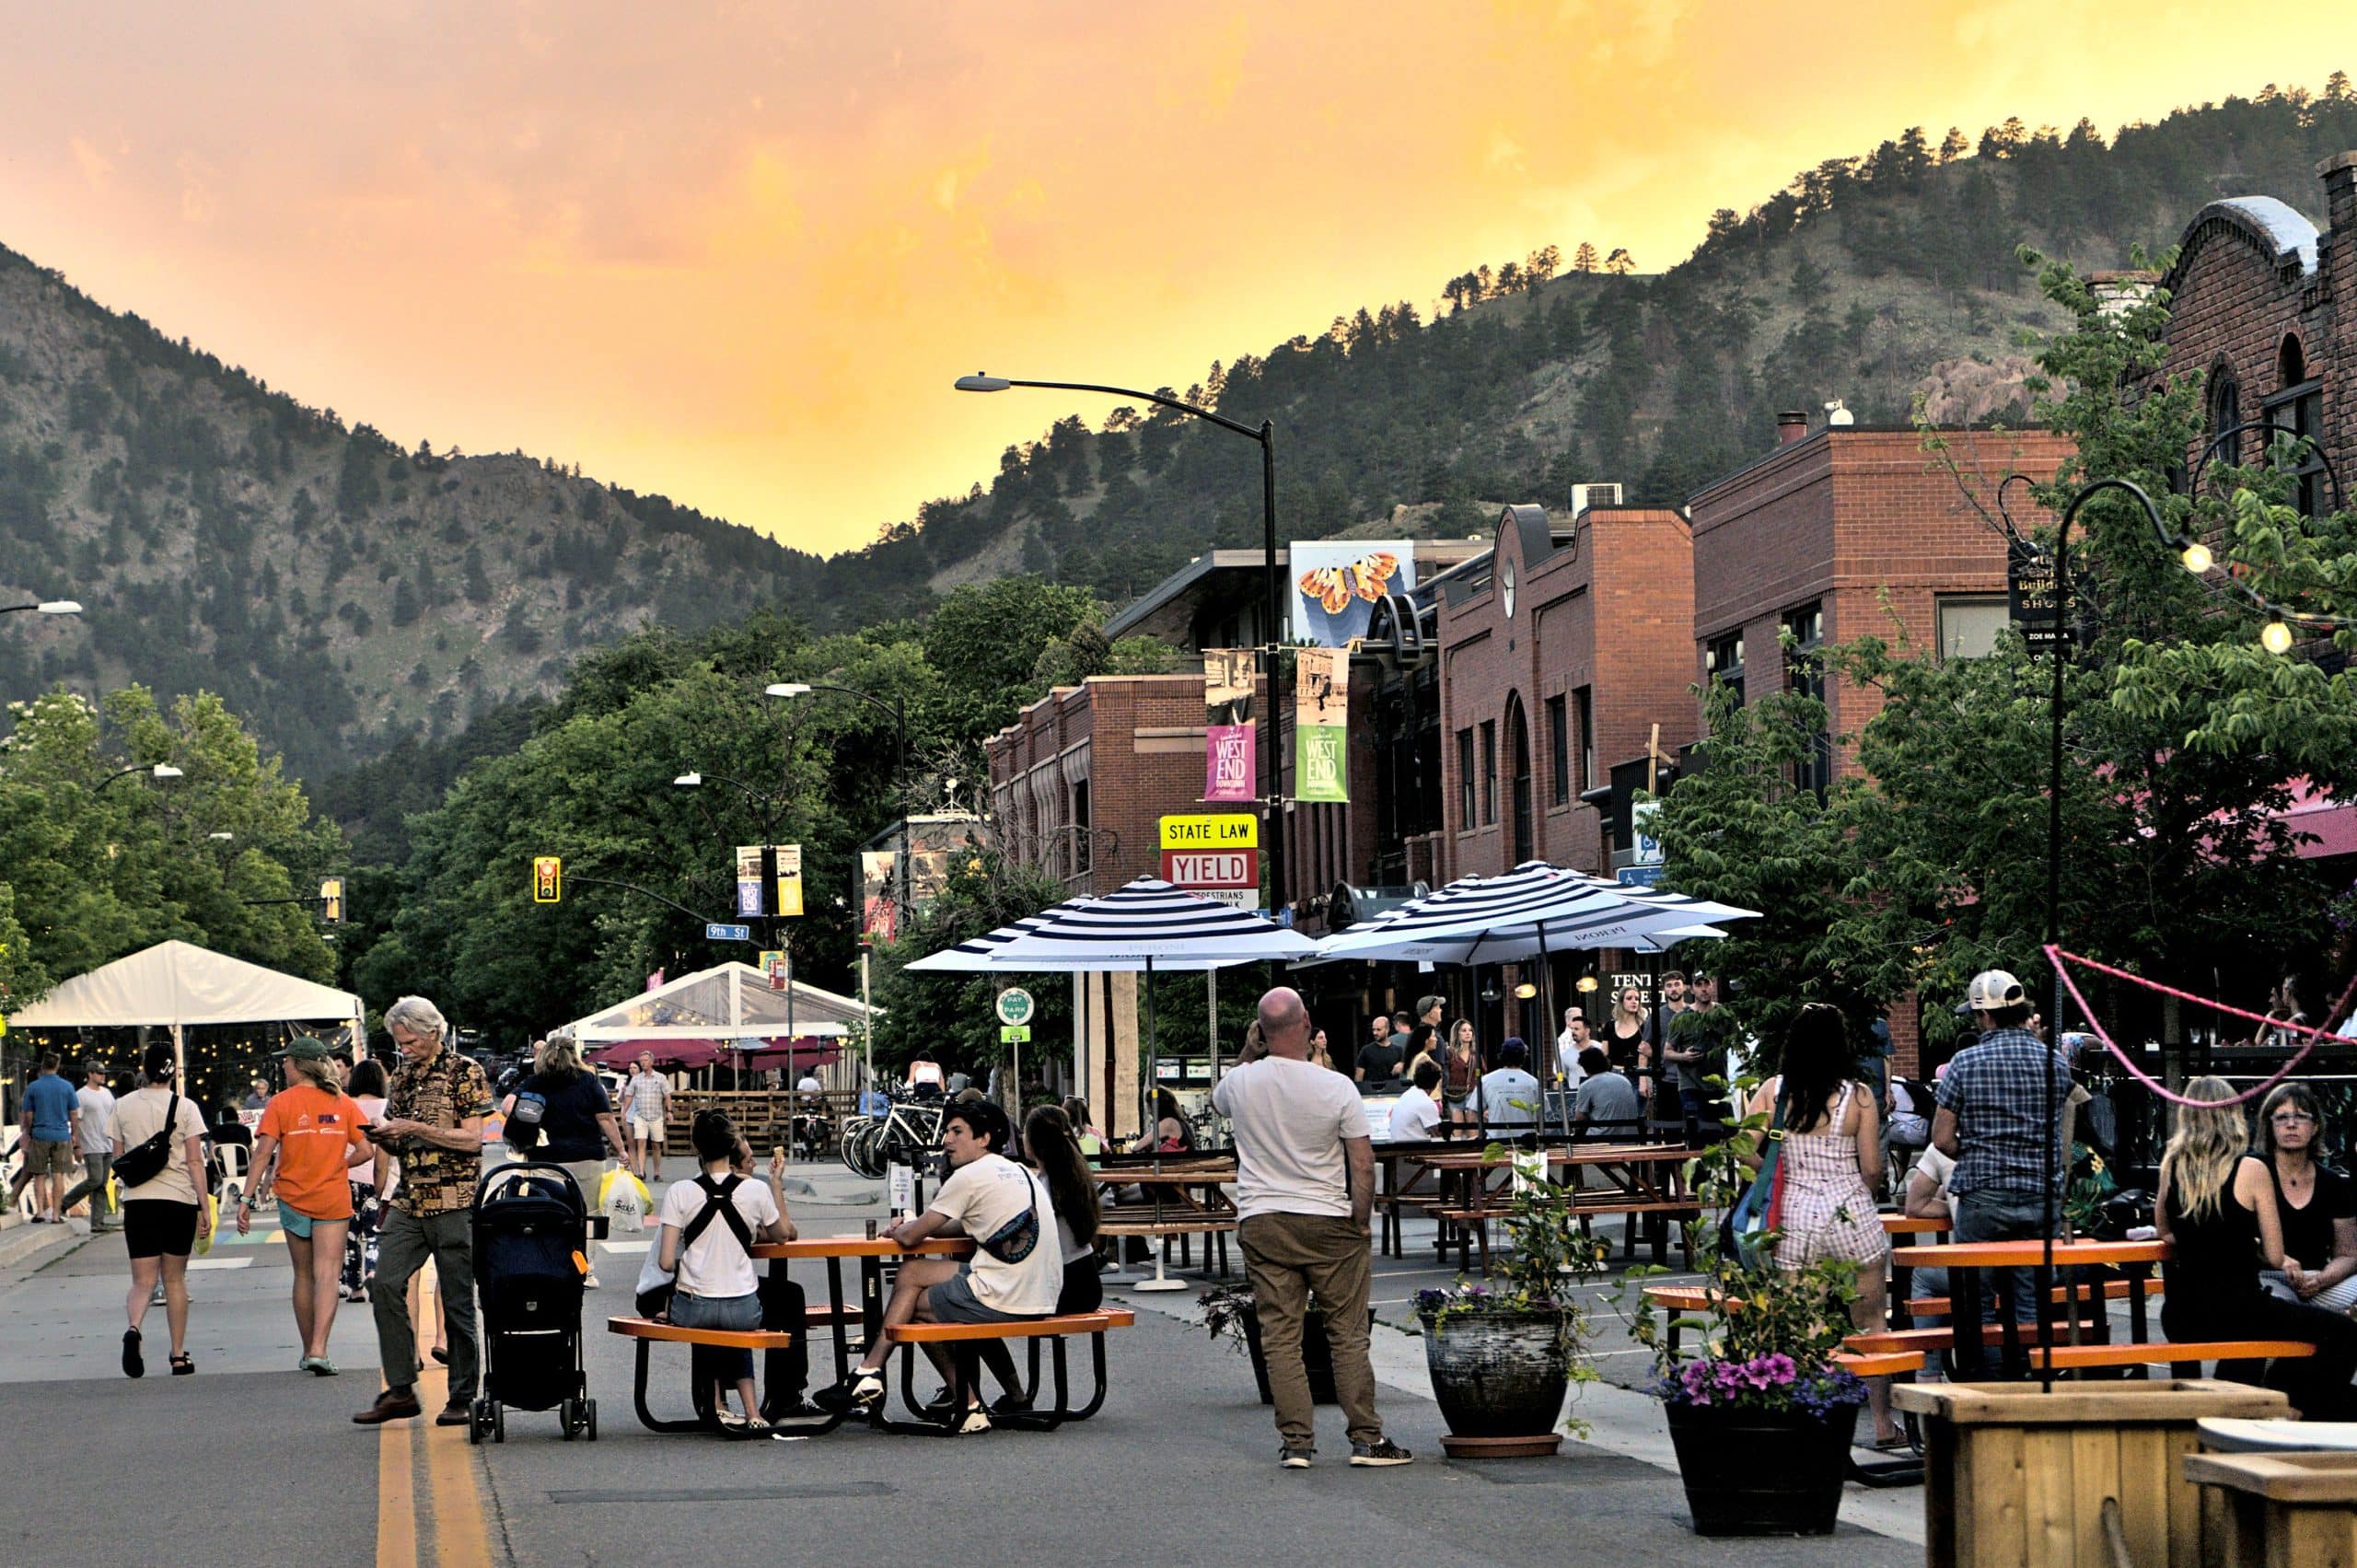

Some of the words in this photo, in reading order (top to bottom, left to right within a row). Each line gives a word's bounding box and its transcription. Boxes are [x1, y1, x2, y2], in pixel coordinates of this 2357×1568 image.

[2022, 597, 2076, 609] SHOS
[1215, 739, 1248, 759] WEST
[1306, 740, 1337, 760] WEST
[1216, 759, 1246, 780] END
[1306, 759, 1337, 780] END
[1169, 824, 1211, 839] STATE
[1220, 824, 1248, 839] LAW
[1176, 857, 1244, 881] YIELD
[1198, 891, 1244, 900] DESTRIANS
[710, 926, 726, 936] 9th
[734, 927, 745, 937] St
[1611, 974, 1663, 987] TENT
